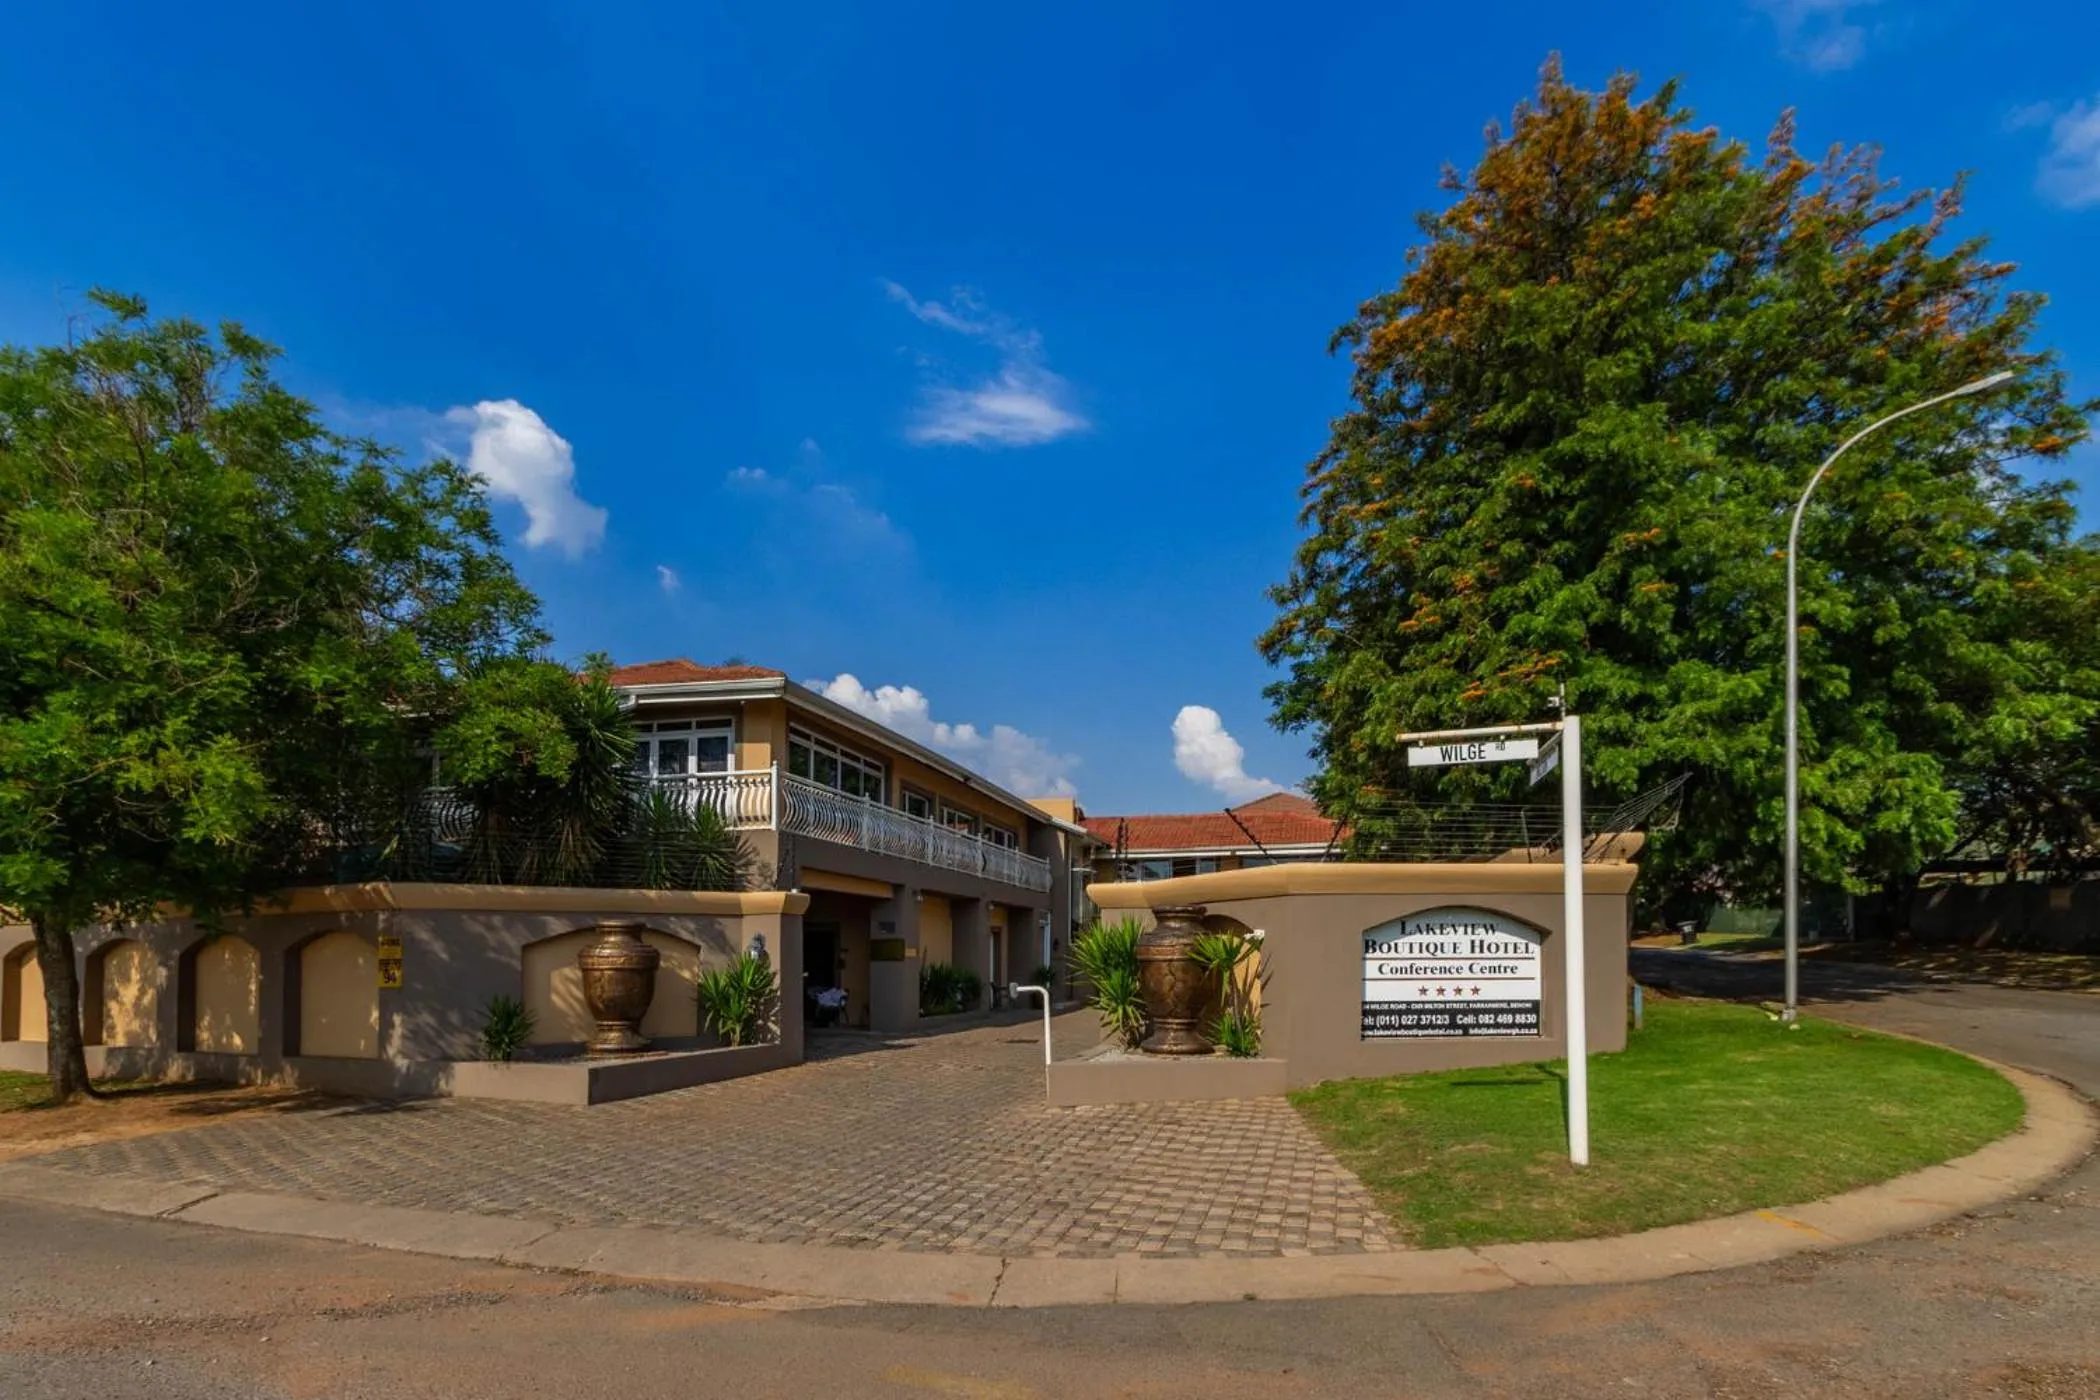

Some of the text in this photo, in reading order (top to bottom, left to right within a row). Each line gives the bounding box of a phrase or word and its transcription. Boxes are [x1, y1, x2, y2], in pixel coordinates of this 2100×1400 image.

[1440, 741, 1506, 762] WILGE RD
[1400, 920, 1500, 936] LAKEVIEW
[1364, 938, 1535, 957] BOUTIQUE HOTEL
[1377, 961, 1518, 976] Conference Centre
[1376, 1015, 1400, 1028] (011)
[1401, 1015, 1418, 1025] 027
[1420, 1015, 1450, 1025] 3712/3
[1456, 1014, 1477, 1025] Cell:
[1478, 1014, 1495, 1024] 082
[1515, 1014, 1537, 1024] 8830
